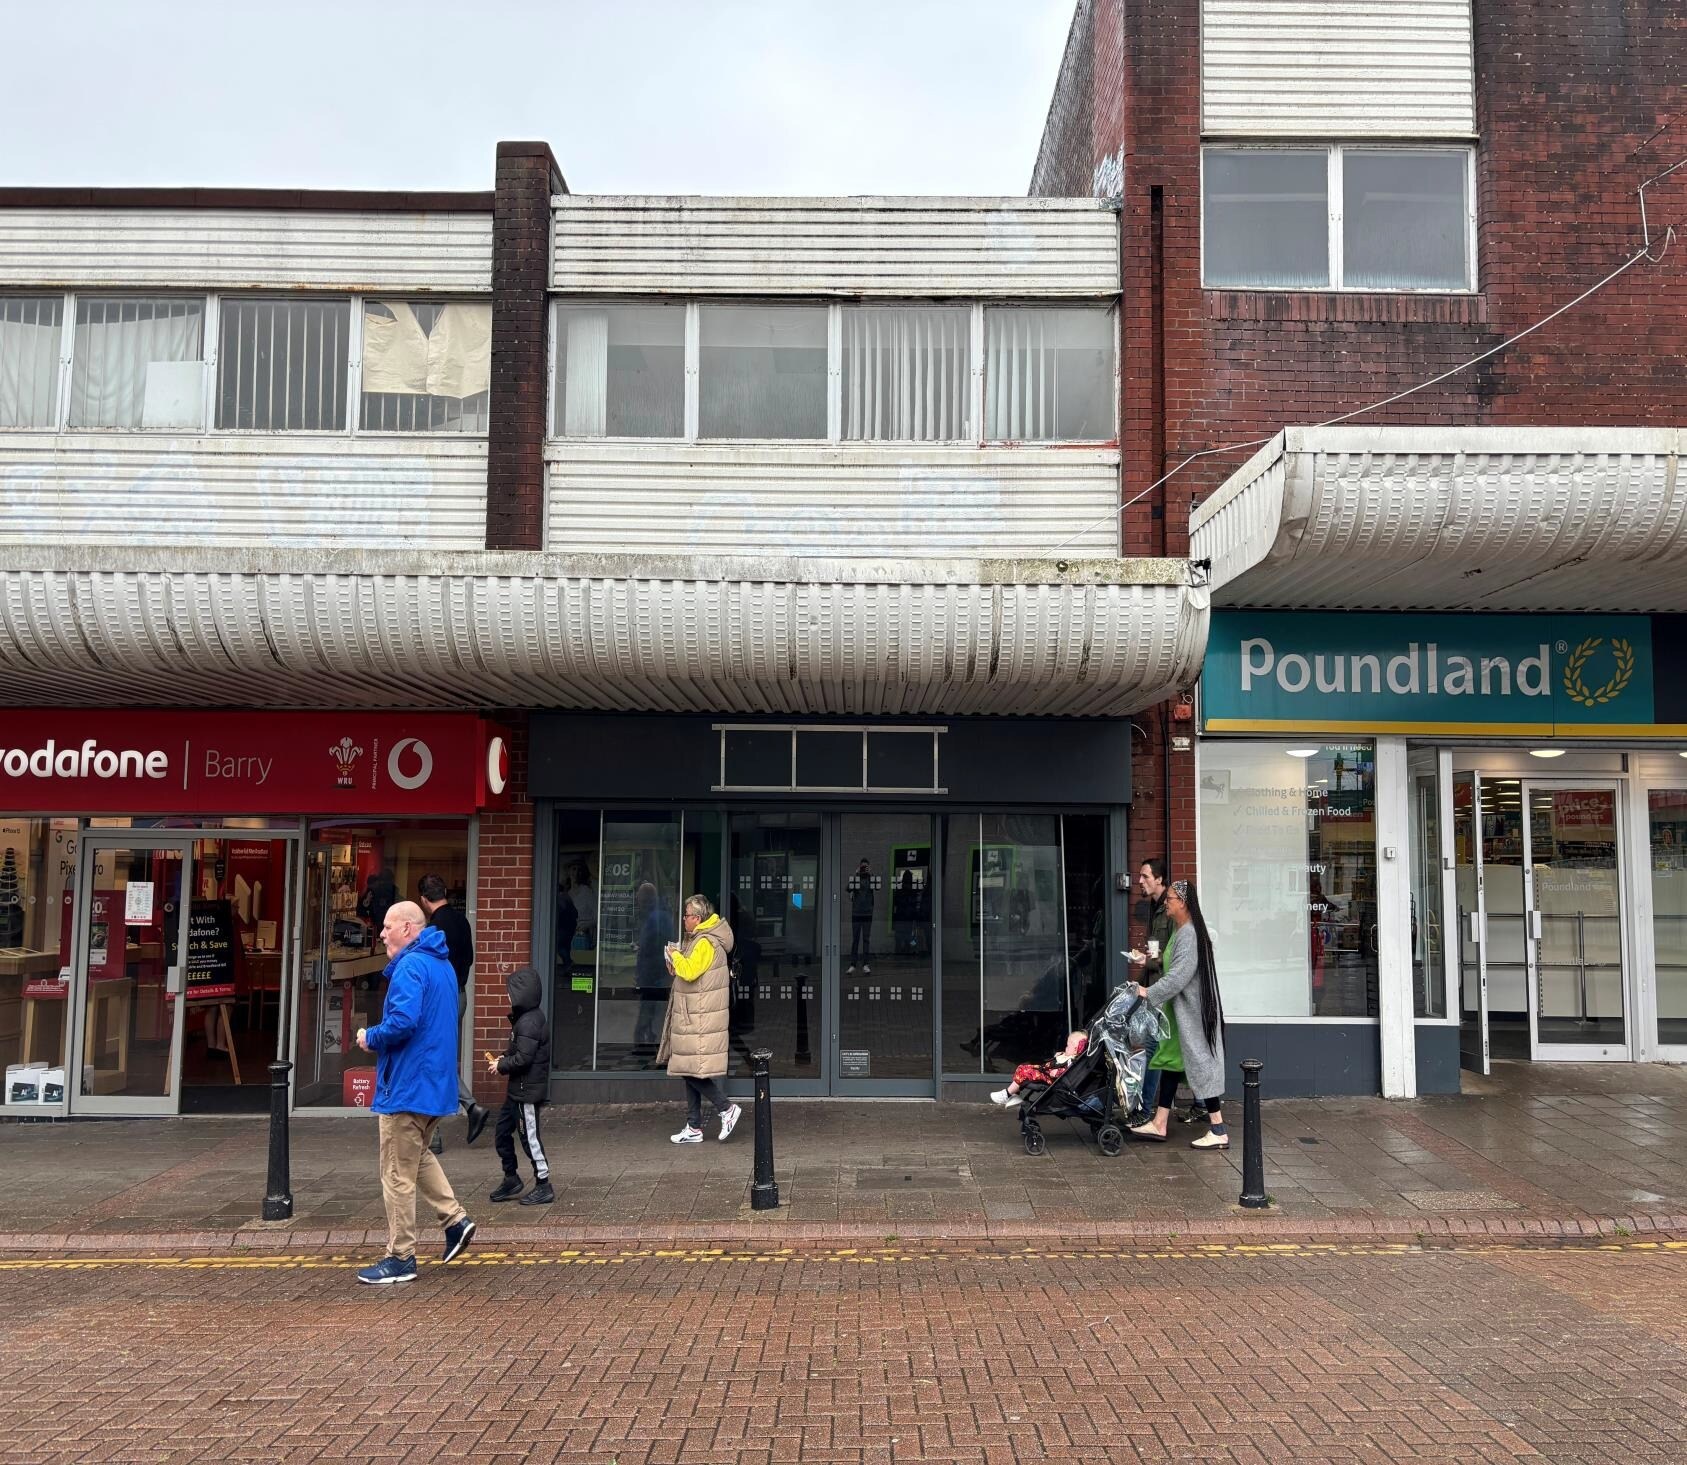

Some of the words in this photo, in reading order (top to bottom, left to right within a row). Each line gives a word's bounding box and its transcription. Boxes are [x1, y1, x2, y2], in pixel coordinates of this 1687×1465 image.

[1240, 638, 1551, 695] Poundland
[0, 739, 168, 778] odafone
[205, 749, 272, 785] Barry
[337, 777, 353, 785] WRU
[1247, 787, 1287, 799] othing
[1299, 787, 1329, 797] Home
[1246, 806, 1279, 816] Chilled
[1292, 806, 1325, 816] Frozen
[1327, 806, 1351, 816] Food
[60, 860, 76, 876] Pixe
[94, 864, 104, 876] ro
[1304, 864, 1326, 875] auty
[1542, 880, 1592, 892] Poundland
[195, 915, 216, 925] With
[171, 941, 199, 951] Sch
[200, 940, 208, 949] &
[209, 940, 228, 949] Save
